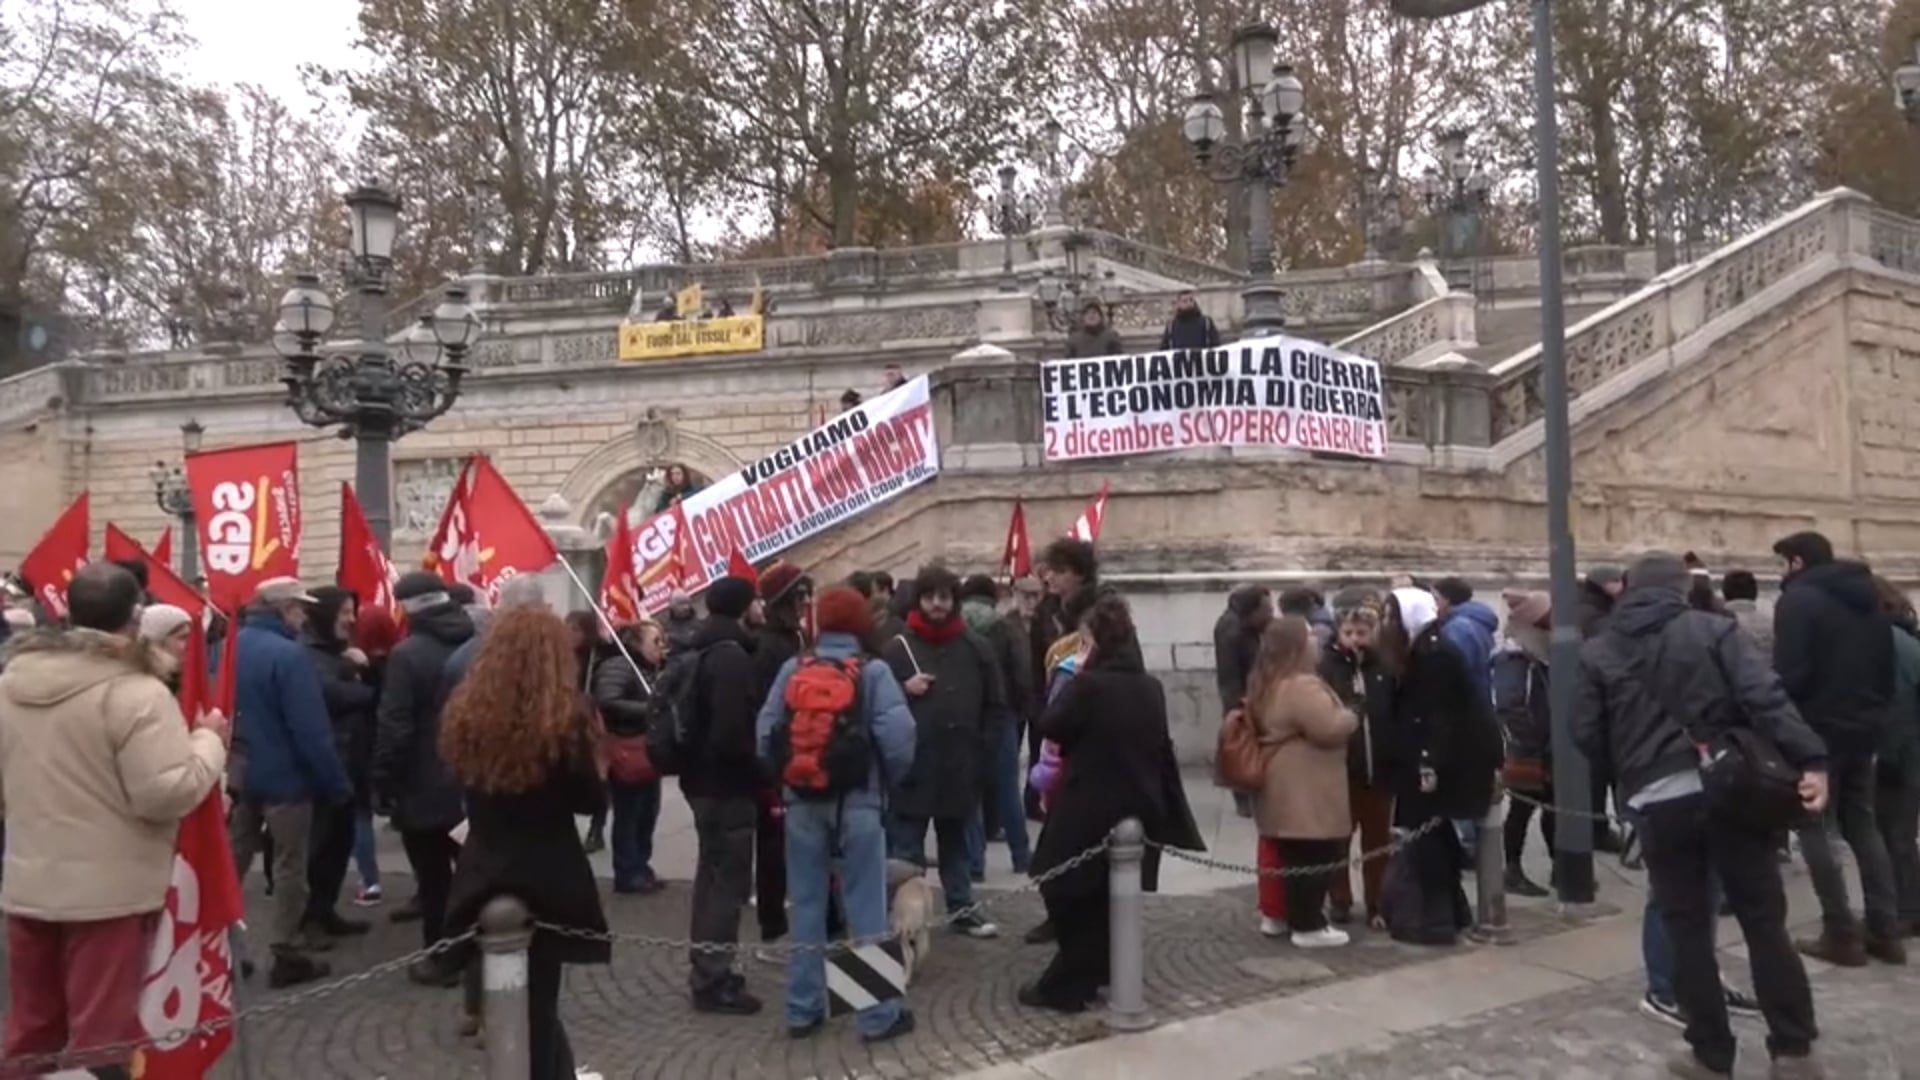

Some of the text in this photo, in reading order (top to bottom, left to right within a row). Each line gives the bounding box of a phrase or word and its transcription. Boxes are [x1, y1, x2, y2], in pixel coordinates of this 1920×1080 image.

[1044, 347, 1379, 394] FERMIAMO LA GUERRA
[1045, 378, 1382, 422] E L'ECONOMIA DI GUERRA
[741, 410, 869, 487] VOGLIAMO
[1045, 426, 1058, 457] 2
[1065, 414, 1175, 456] dicembre
[1180, 409, 1291, 445] SCIOPERO
[692, 466, 815, 565] CONTRATTI
[803, 441, 865, 509] NON
[707, 531, 785, 579] LAVATRICI
[785, 526, 794, 541] E
[794, 488, 871, 536] LAVORATORI
[869, 474, 905, 499] COOP
